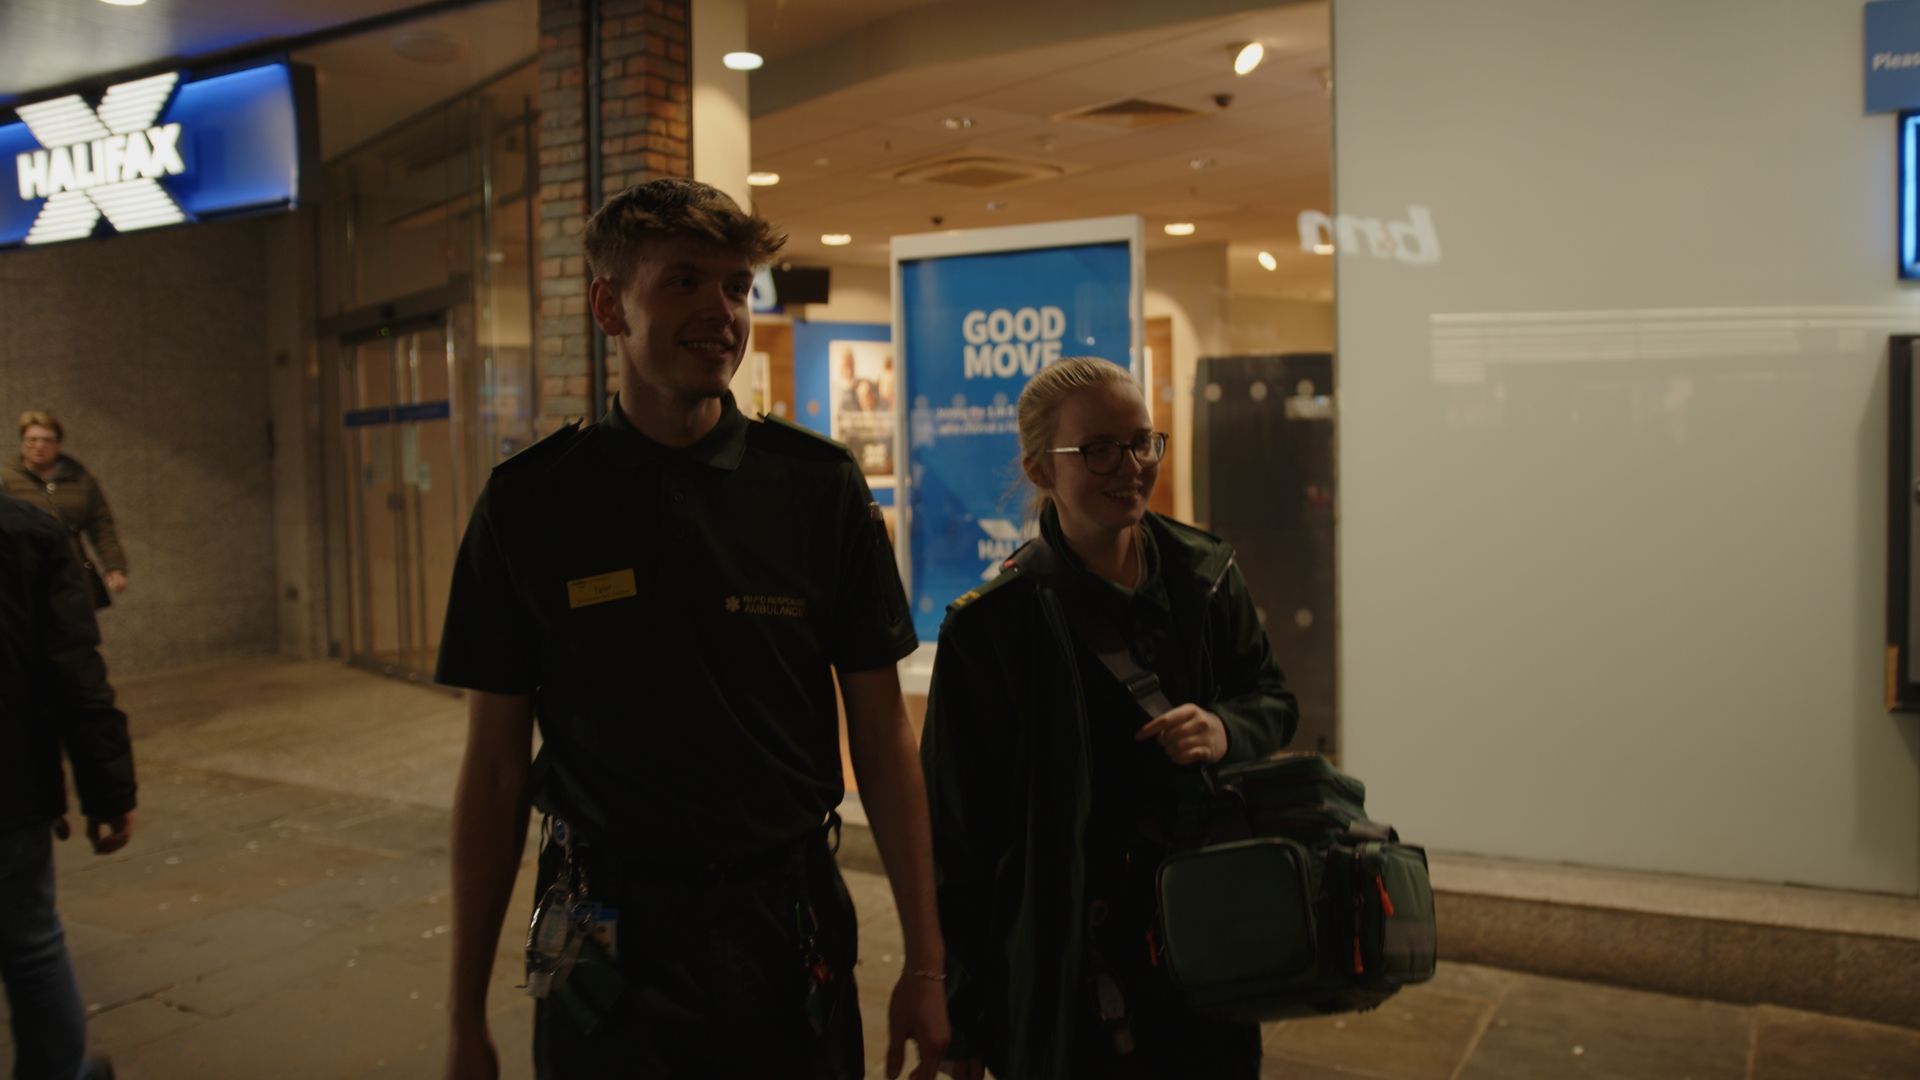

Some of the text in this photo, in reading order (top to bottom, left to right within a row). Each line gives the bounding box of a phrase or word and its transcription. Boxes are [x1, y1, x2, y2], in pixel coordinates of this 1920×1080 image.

[1871, 51, 1920, 72] Pleas
[16, 121, 187, 201] HALIFAX
[962, 305, 1067, 345] GOOD
